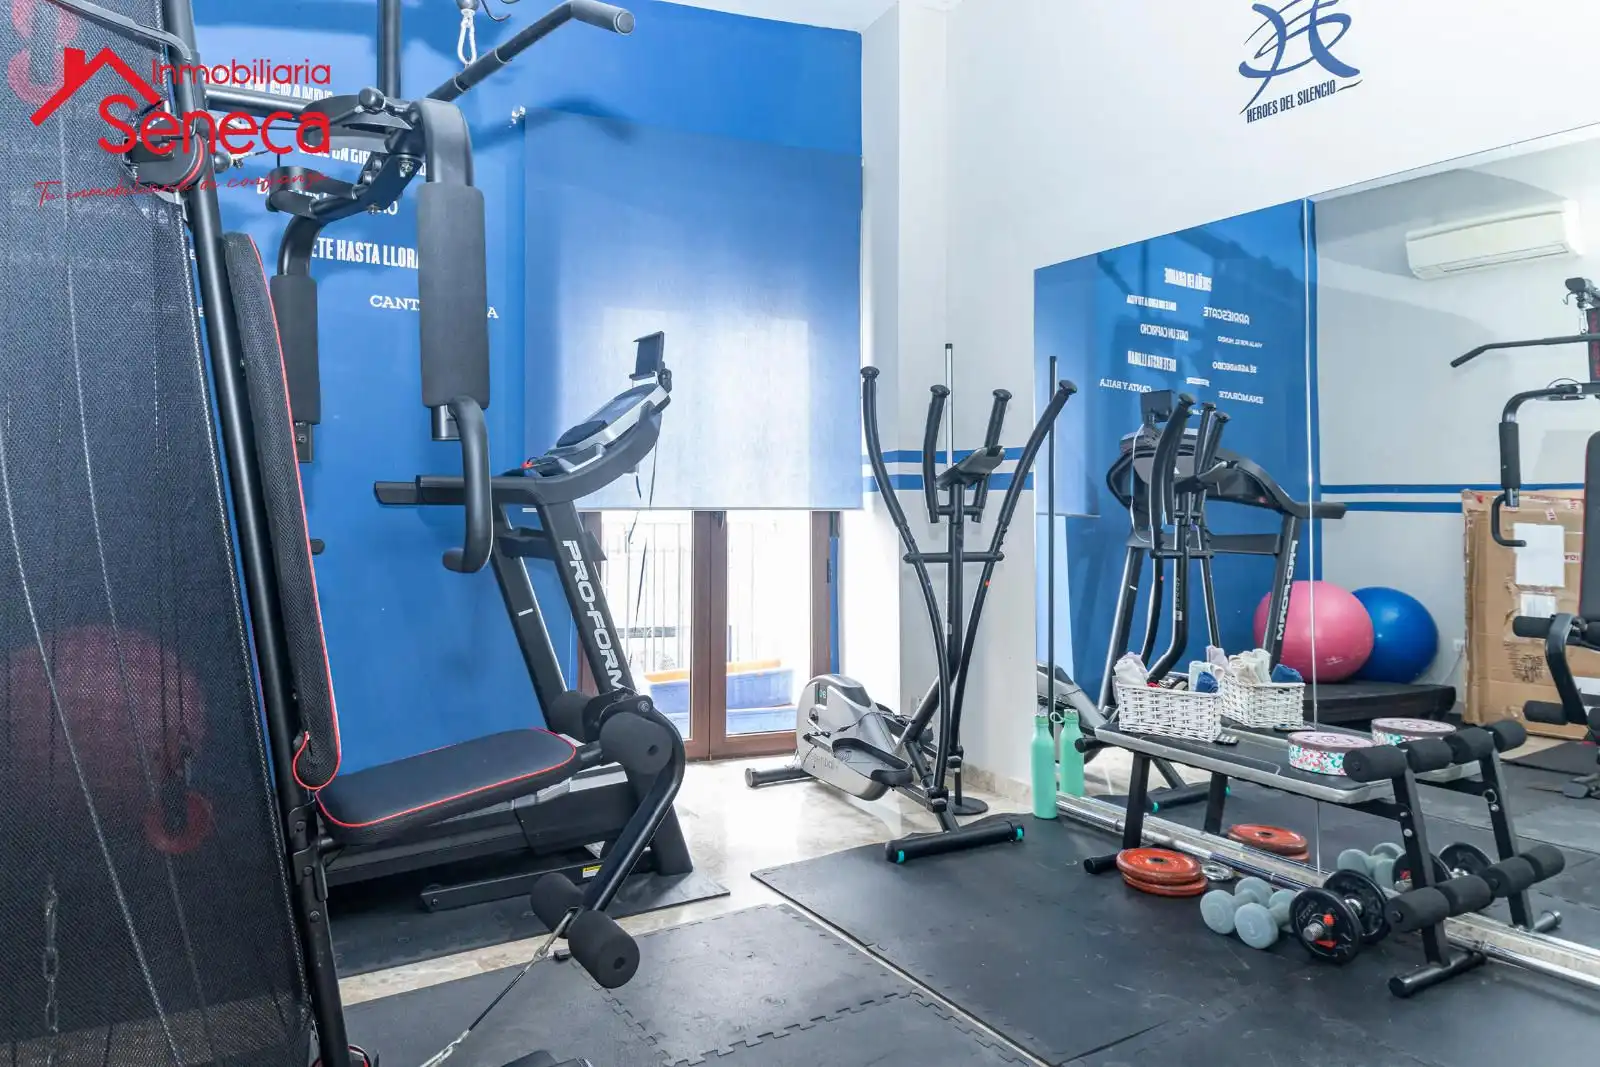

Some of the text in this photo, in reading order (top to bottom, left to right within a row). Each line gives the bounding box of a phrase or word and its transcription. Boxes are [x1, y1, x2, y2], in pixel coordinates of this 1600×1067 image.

[1247, 79, 1336, 124] HEROES DEL SILENCIO
[336, 239, 381, 265] HASTA
[562, 540, 624, 692] PRO-FORM
